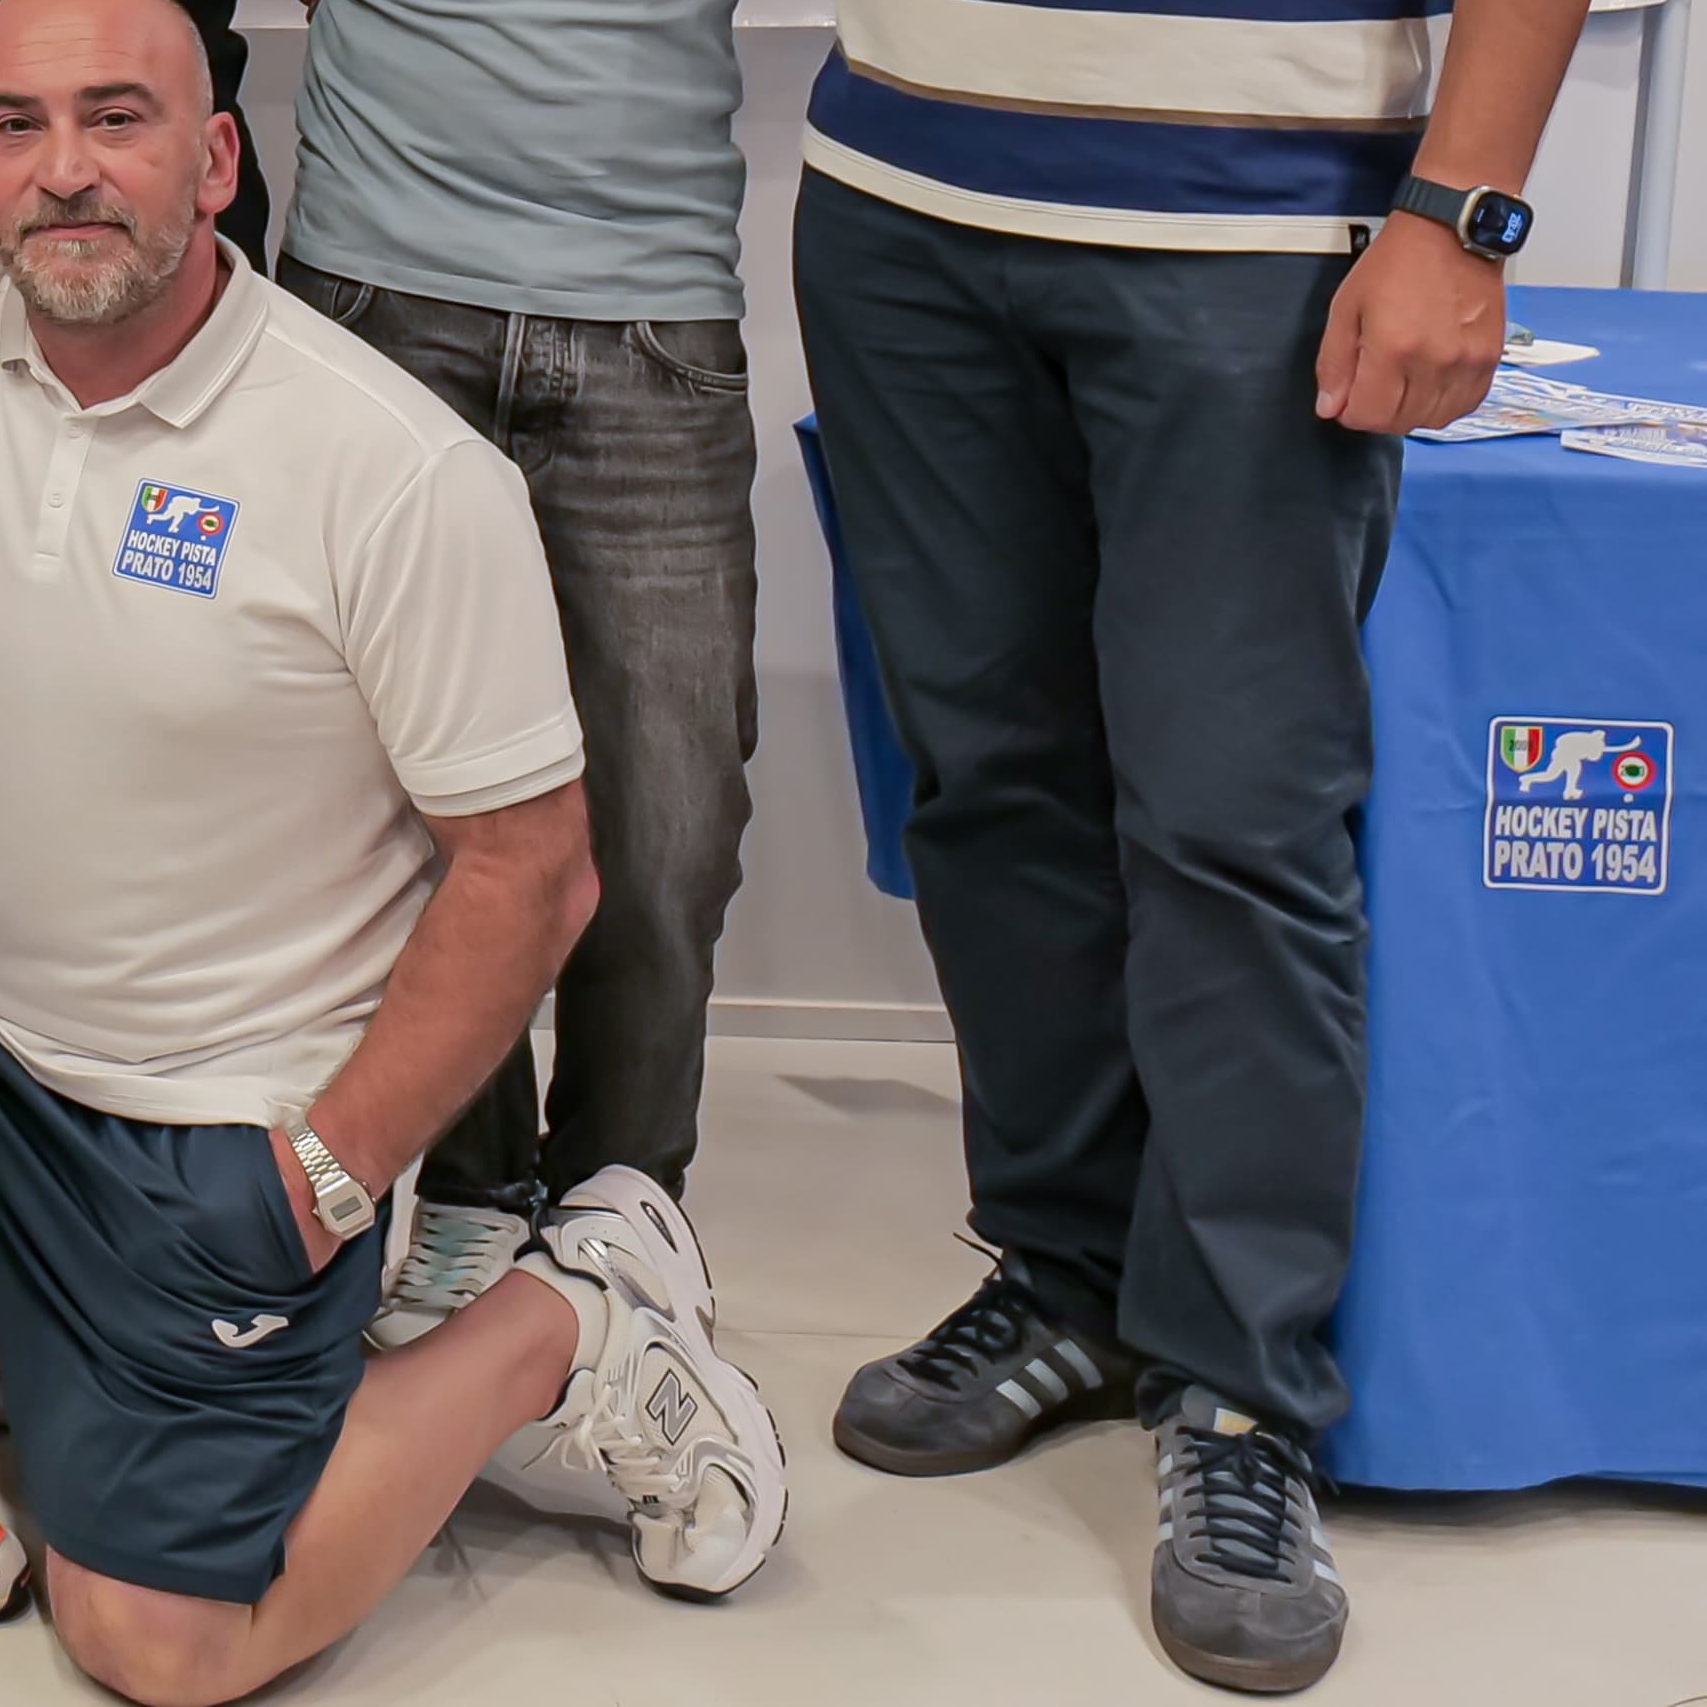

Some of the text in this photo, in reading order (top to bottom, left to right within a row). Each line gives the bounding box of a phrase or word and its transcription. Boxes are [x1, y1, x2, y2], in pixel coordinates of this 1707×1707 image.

[128, 529, 217, 567] HOCKEY PISTA
[121, 550, 212, 590] PRATO 1954
[1495, 805, 1658, 842] HOCKEY PISTA
[1493, 839, 1657, 883] PRATO 1954
